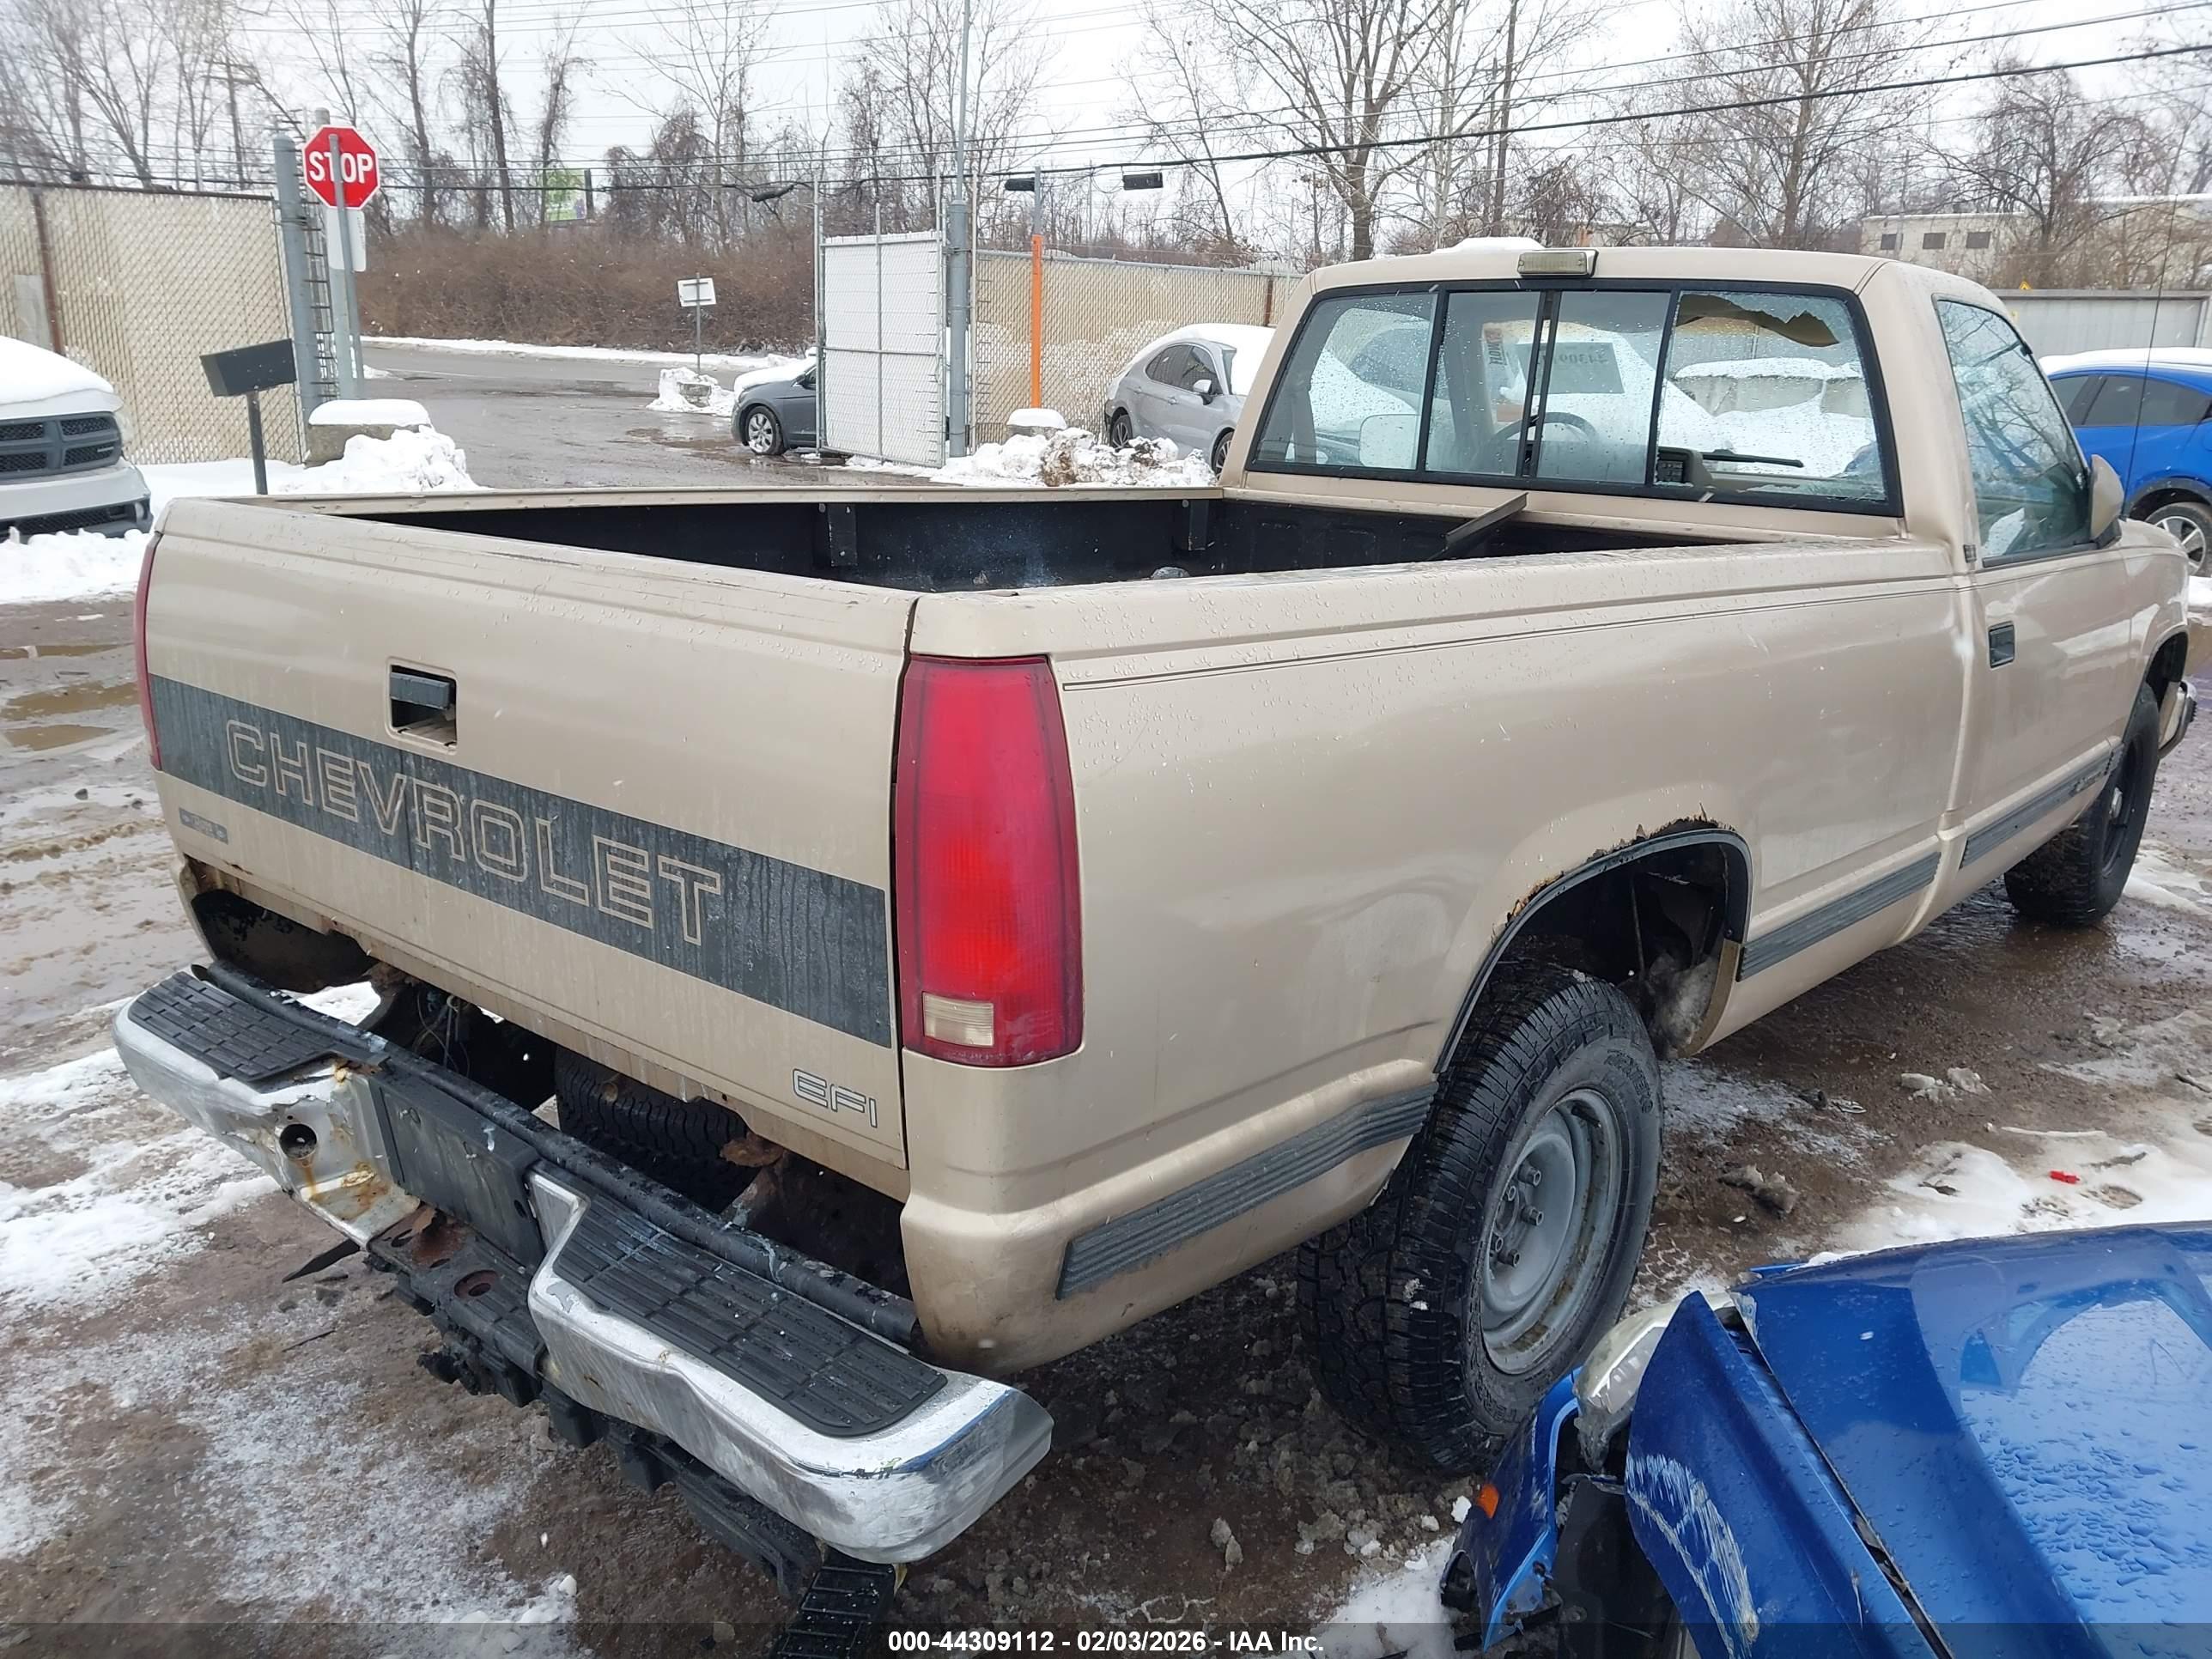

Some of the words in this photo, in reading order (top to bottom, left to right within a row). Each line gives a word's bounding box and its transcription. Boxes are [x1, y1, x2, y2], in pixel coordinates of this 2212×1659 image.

[308, 150, 374, 185] STOP
[226, 719, 721, 946] CHEVROLET
[793, 1067, 878, 1128] EFI
